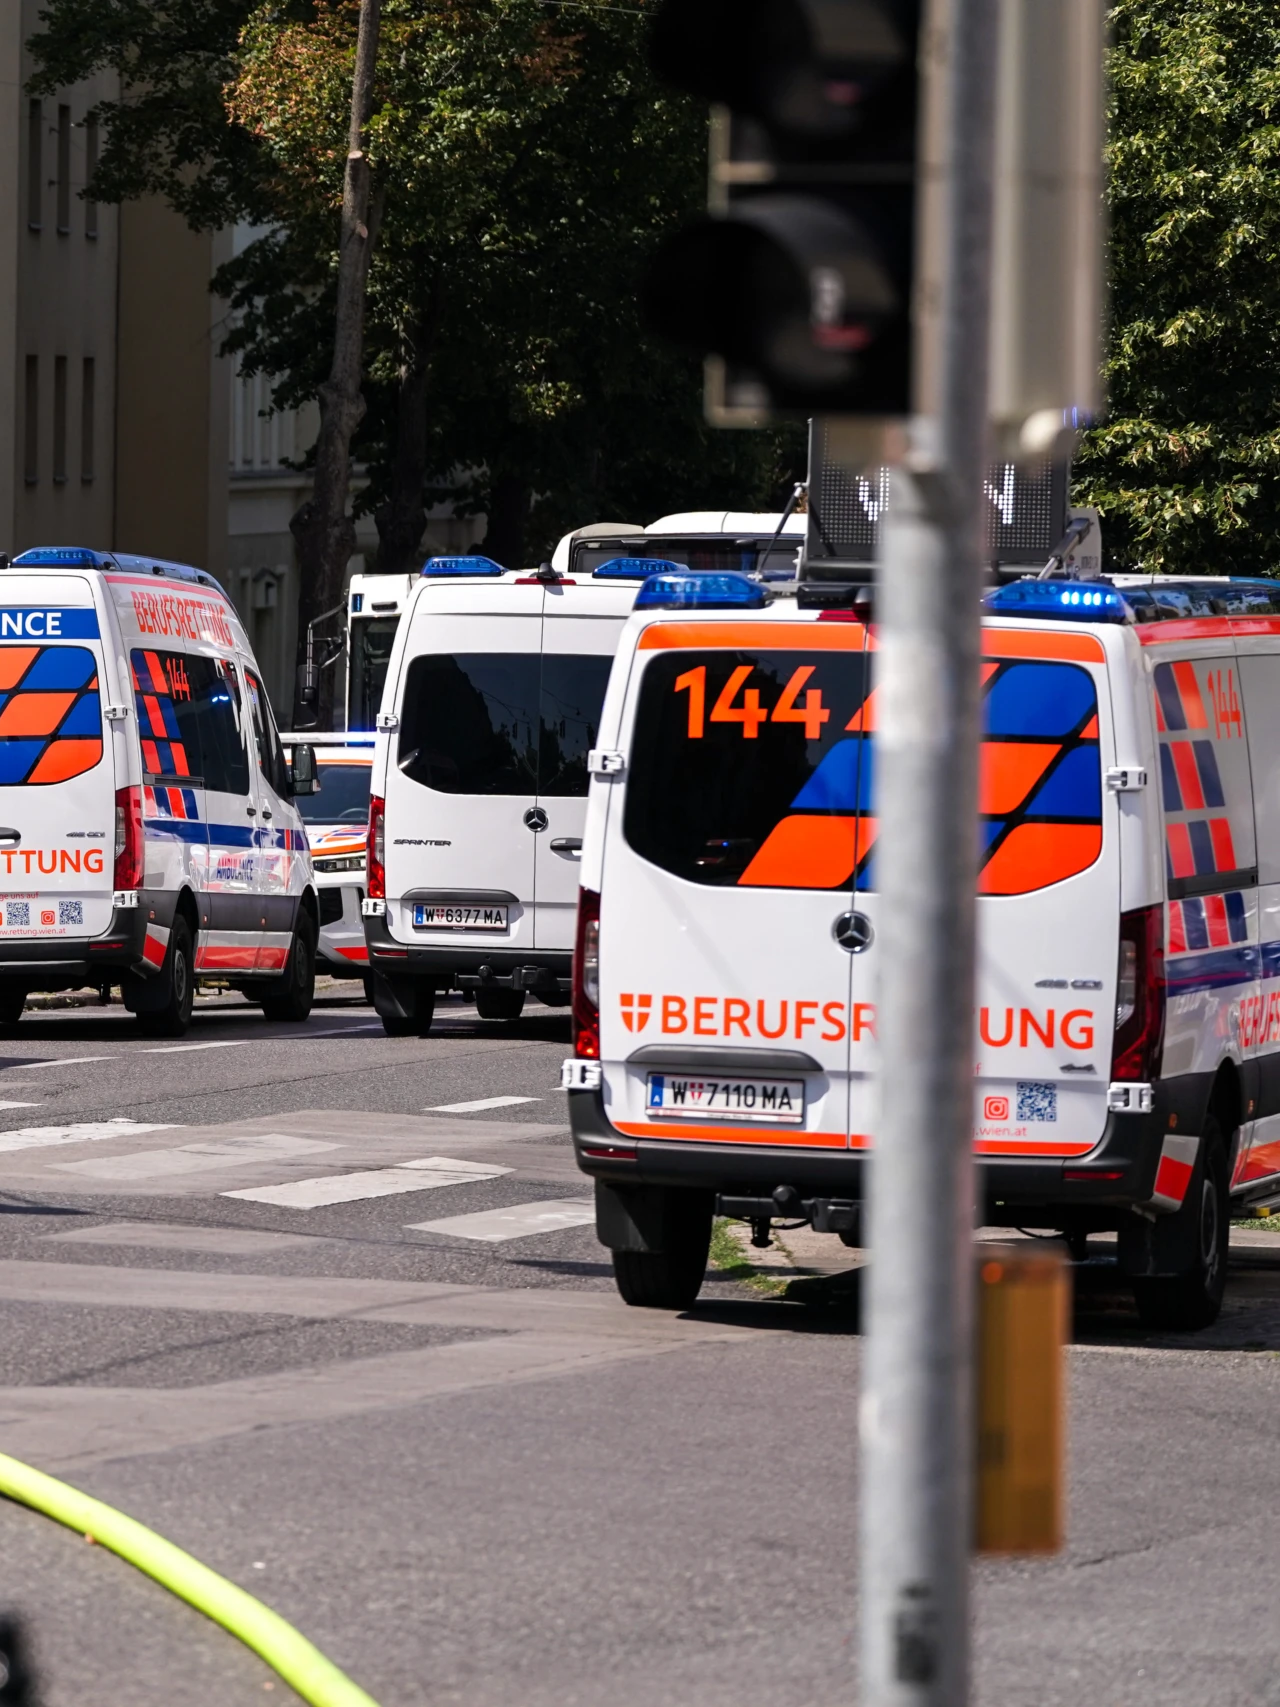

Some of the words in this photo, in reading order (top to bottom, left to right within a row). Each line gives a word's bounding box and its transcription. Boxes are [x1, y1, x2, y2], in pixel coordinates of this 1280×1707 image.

[131, 591, 233, 646] BERUFSRETTUNG
[166, 658, 190, 701] 144
[674, 665, 830, 739] 144
[1207, 669, 1242, 740] 144
[393, 839, 451, 847] SPRINTER
[26, 891, 39, 899] auf
[425, 908, 435, 922] W
[446, 908, 481, 923] 6377
[484, 910, 503, 924] MA
[661, 995, 1094, 1050] BERUFSRUNG
[671, 1081, 688, 1105] W
[707, 1084, 756, 1108] 7110
[762, 1086, 793, 1111] MA
